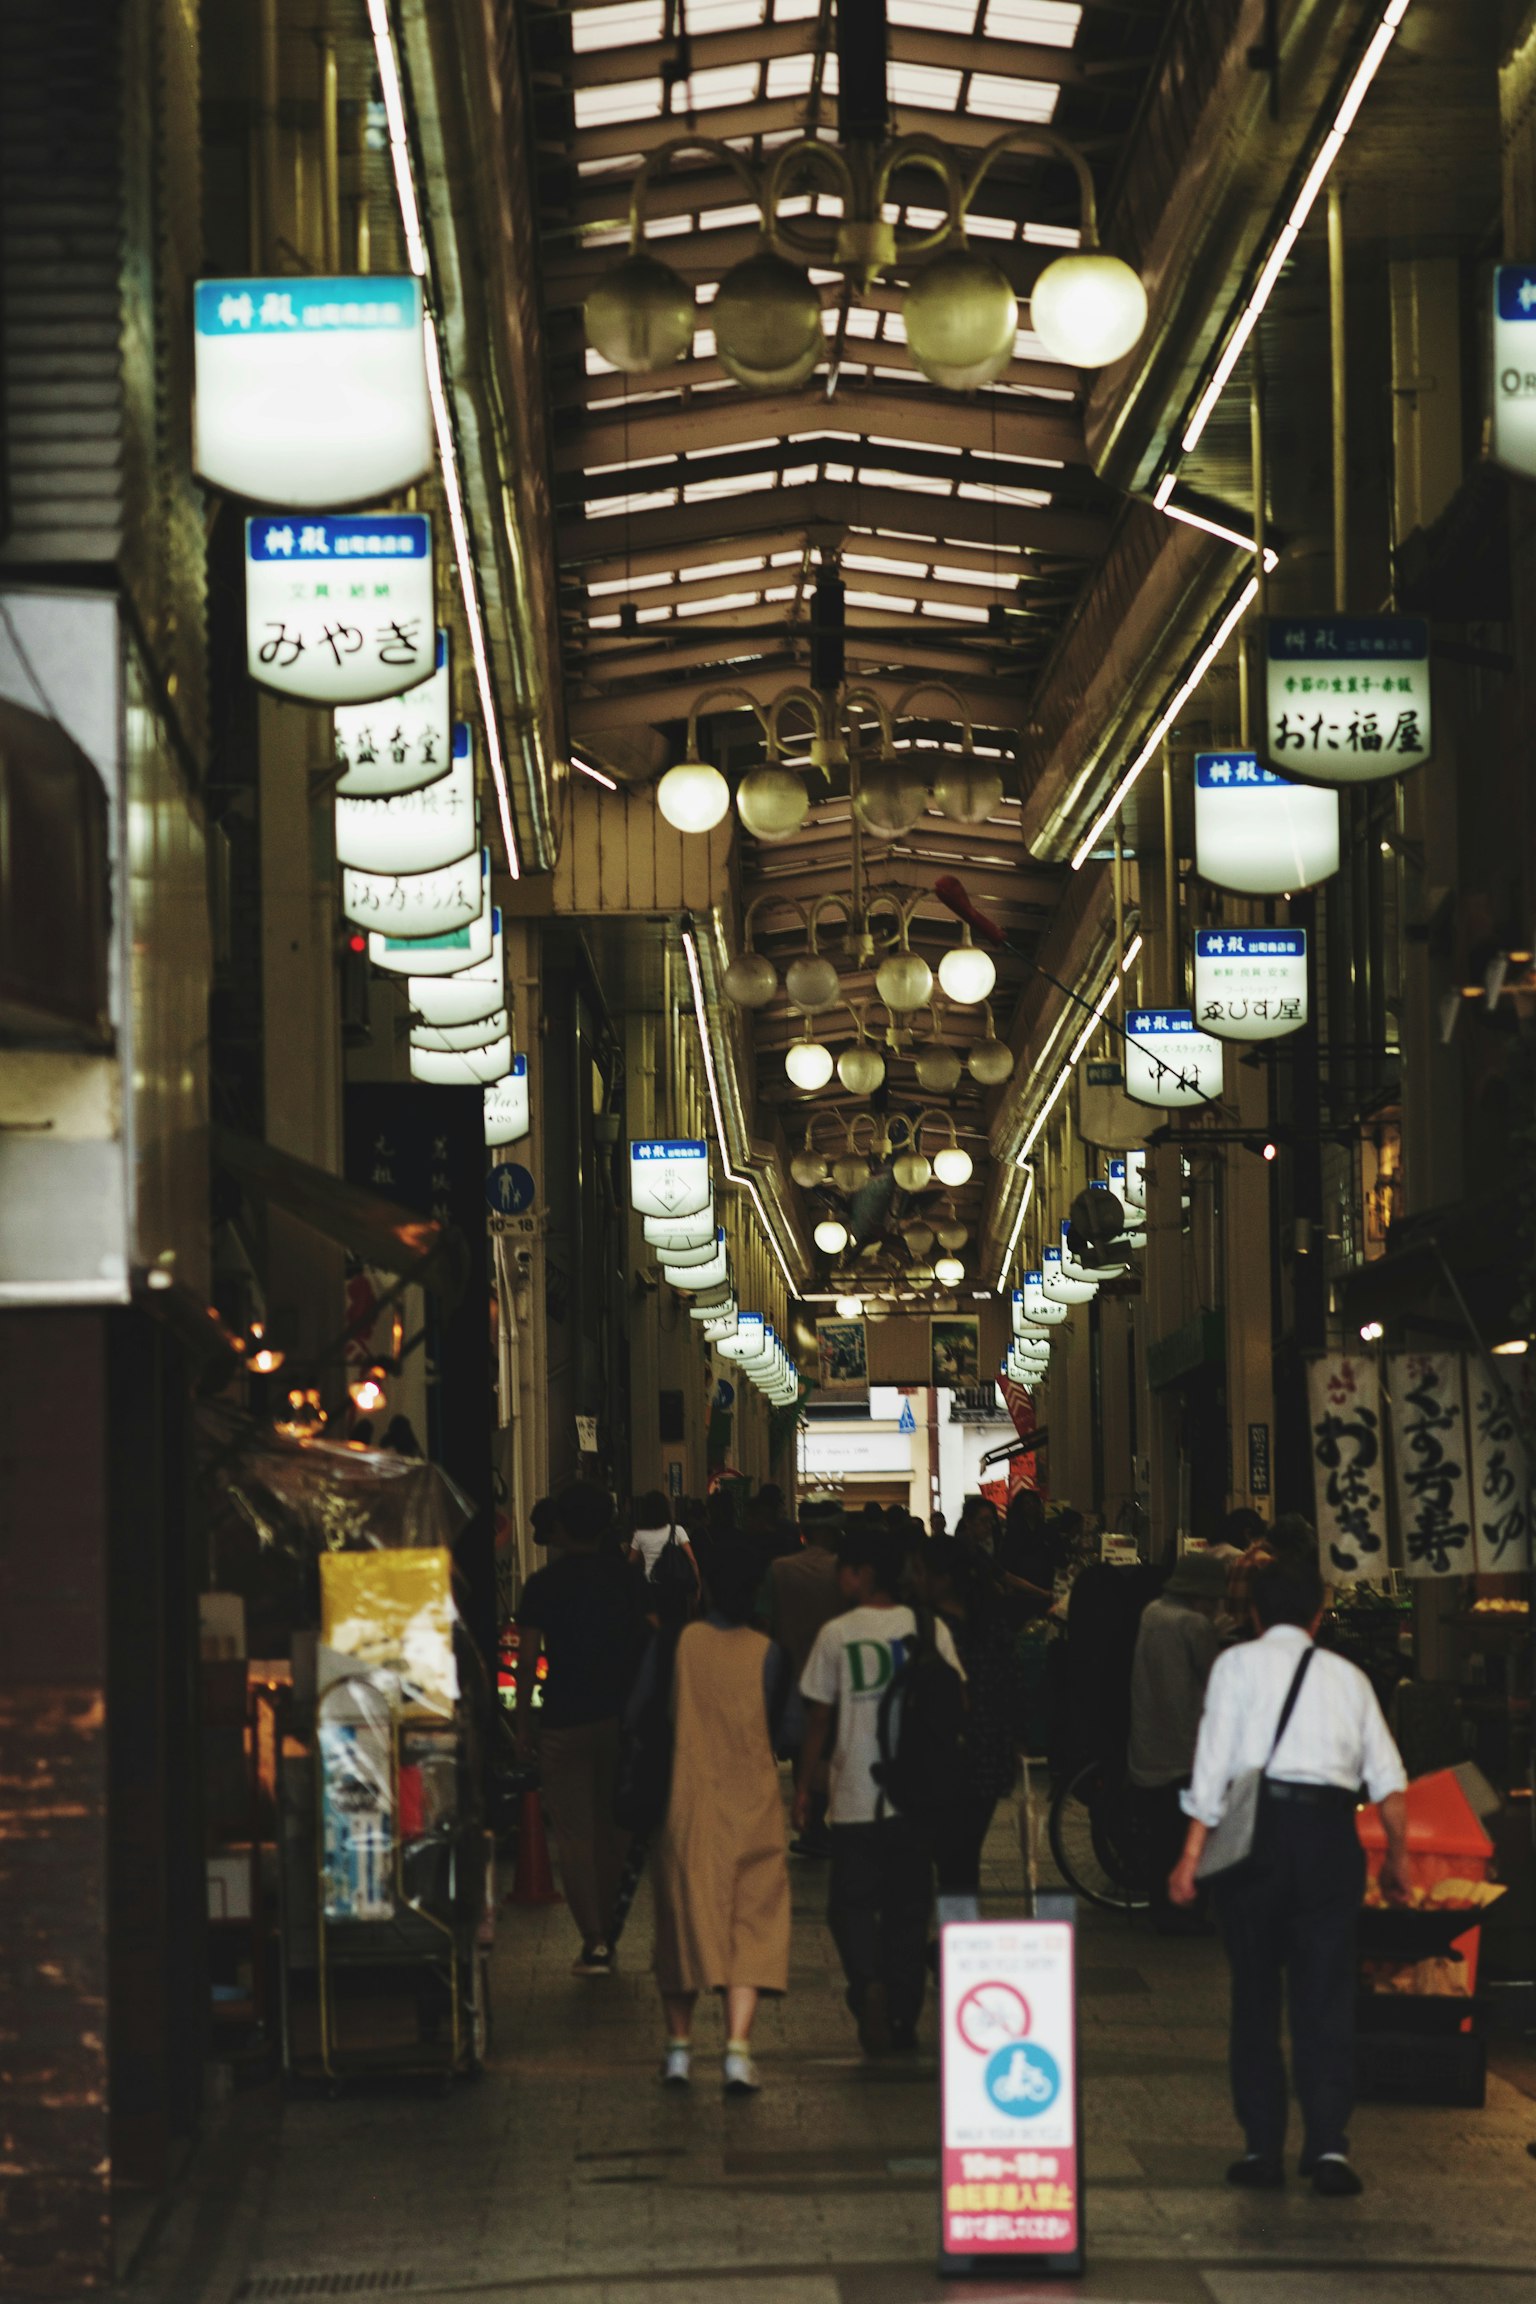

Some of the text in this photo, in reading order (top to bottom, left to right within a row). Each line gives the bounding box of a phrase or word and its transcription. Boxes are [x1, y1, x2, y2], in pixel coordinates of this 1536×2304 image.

[259, 618, 421, 667] みやぎ
[1275, 709, 1424, 754] おた福屋
[1201, 997, 1304, 1021] ゑびす屋
